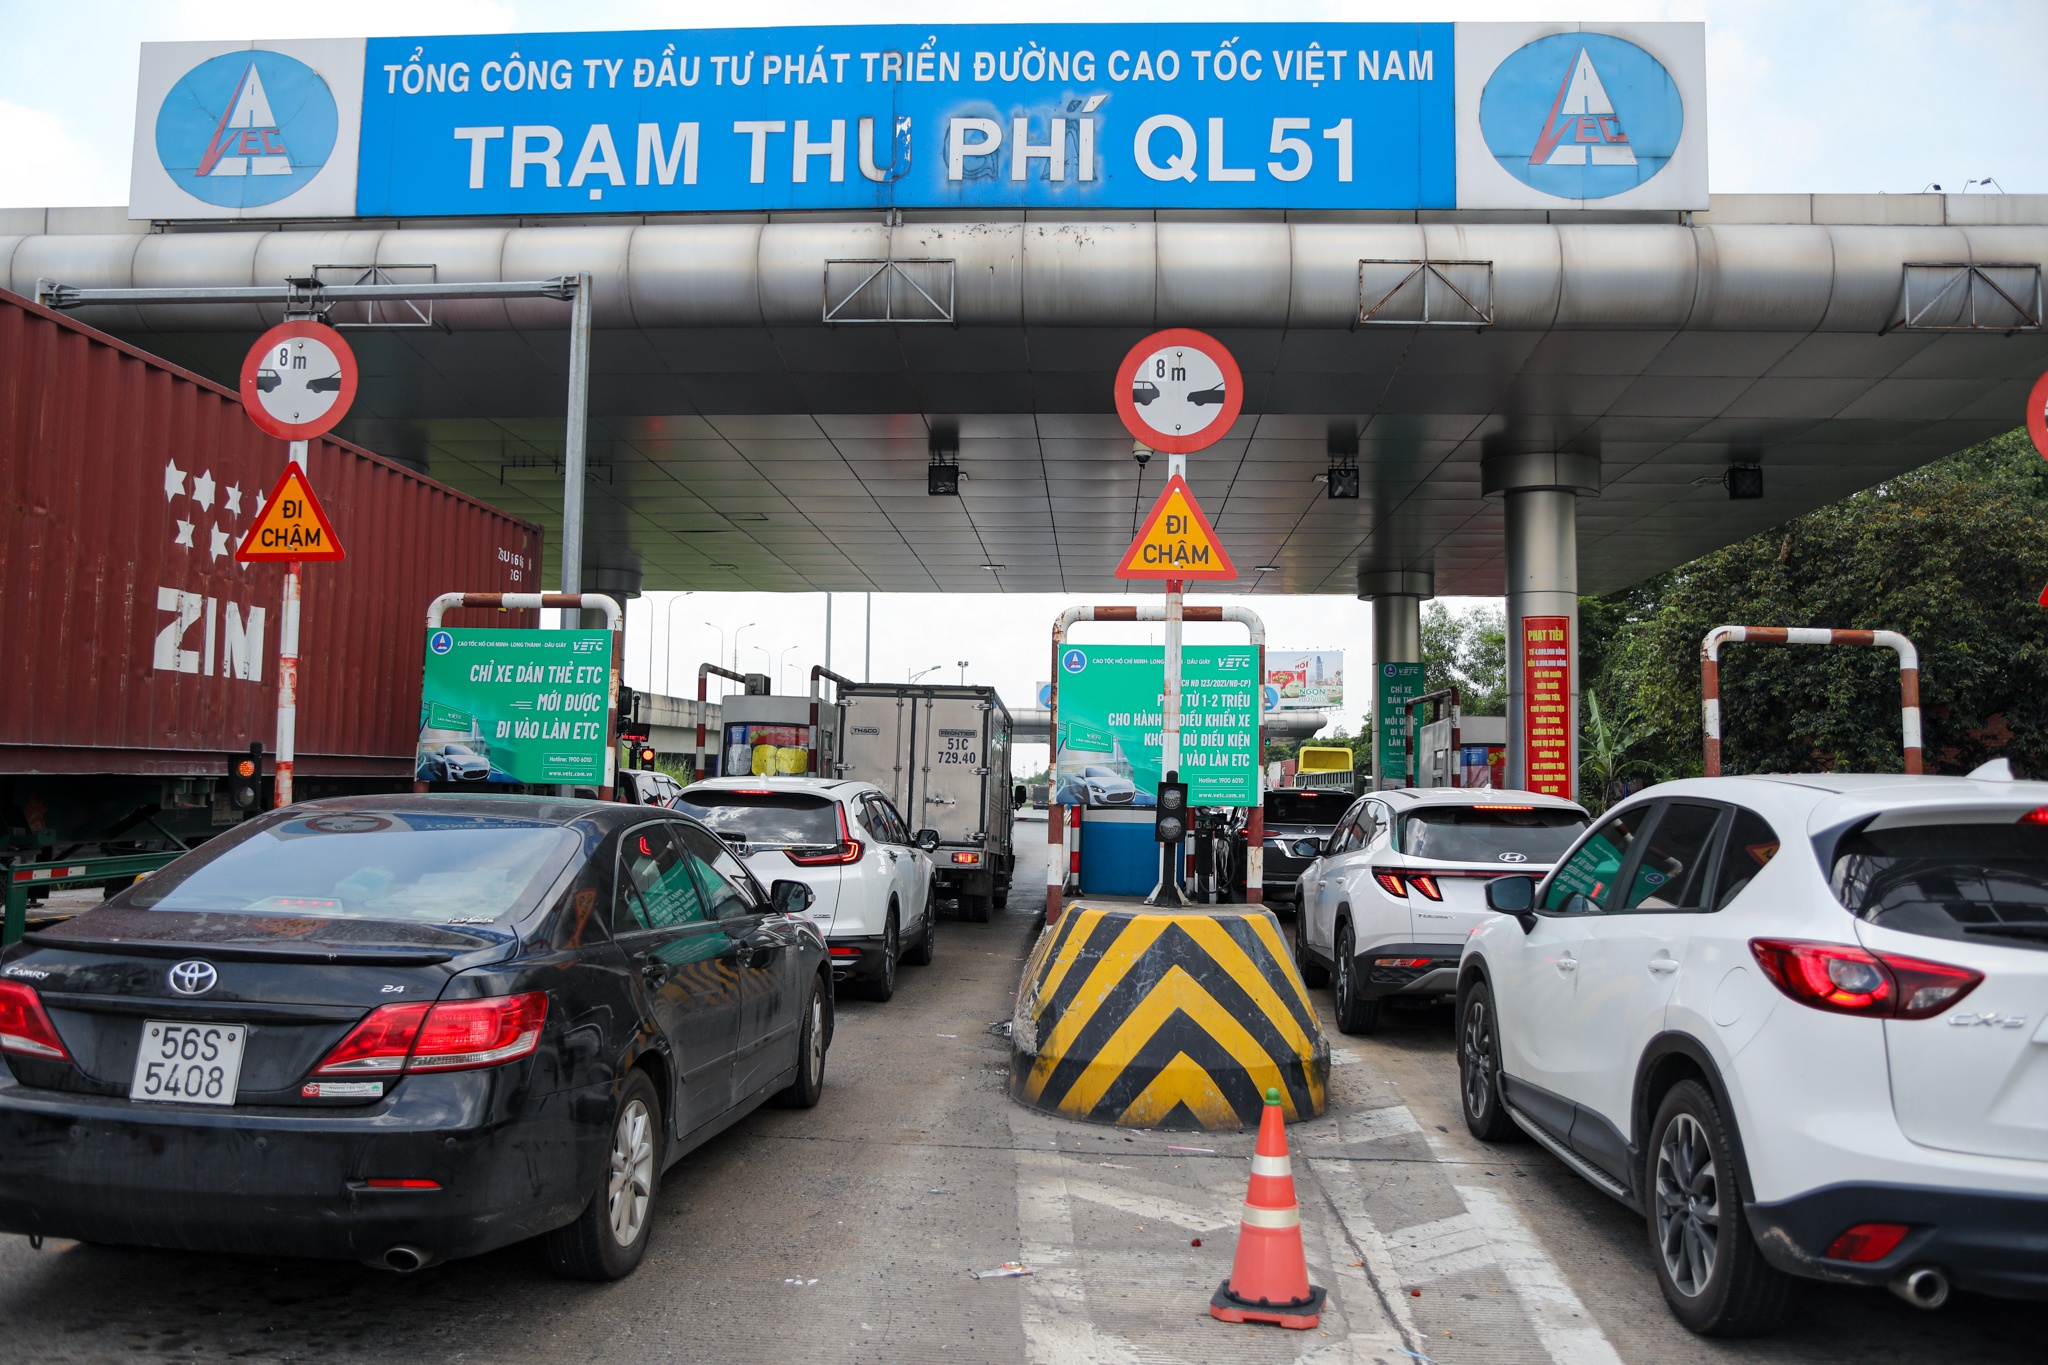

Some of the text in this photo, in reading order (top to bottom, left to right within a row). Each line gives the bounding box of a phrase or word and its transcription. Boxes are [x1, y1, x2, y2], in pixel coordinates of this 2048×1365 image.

[384, 35, 1434, 94] TỔNG CÔNG TY ĐẦU TƯ PHÁT TRIỂN ĐƯỜNG CAO TỐC VIỆT NAM
[454, 122, 699, 200] TRẠM
[733, 116, 912, 183] THU
[948, 94, 1108, 182] PHÍ
[279, 347, 307, 370] 8 m
[1156, 358, 1186, 381] 8 m
[282, 500, 303, 519] ĐI
[1166, 514, 1188, 535] ĐI
[261, 524, 321, 551] CHẬM
[1143, 540, 1209, 569] CHẬM
[1528, 626, 1563, 643] PHẠT TIỀN
[573, 640, 604, 652] VETC
[470, 659, 603, 684] CHỈ XE DÁN THẺ ETC
[1218, 657, 1250, 668] VETC
[1391, 684, 1412, 694] CHỈ XE
[537, 689, 601, 717] MỚI ĐƯỢC
[1186, 690, 1199, 707] TỪ
[1202, 694, 1218, 707] 1-2
[1221, 691, 1250, 710] TRIỆU
[496, 717, 600, 740] ĐI VÀO LÀN ETC
[1108, 713, 1130, 727] CHO
[1133, 710, 1162, 727] HÀNH
[1205, 709, 1235, 727] KHIỂN
[1238, 714, 1250, 727] XE
[947, 738, 969, 750] 51C
[1183, 729, 1197, 747] ĐỦ
[1200, 730, 1224, 747] ĐIỀU
[1227, 731, 1250, 750] KIỆN
[938, 751, 976, 764] 729.40
[1186, 750, 1206, 766] VÀO
[1210, 750, 1228, 766] LÀN
[1232, 754, 1250, 767] ETC
[6, 967, 50, 980] CAMRY
[1948, 1012, 2027, 1028] CX-5
[161, 1026, 222, 1062] 56S
[144, 1062, 224, 1098] 5408
